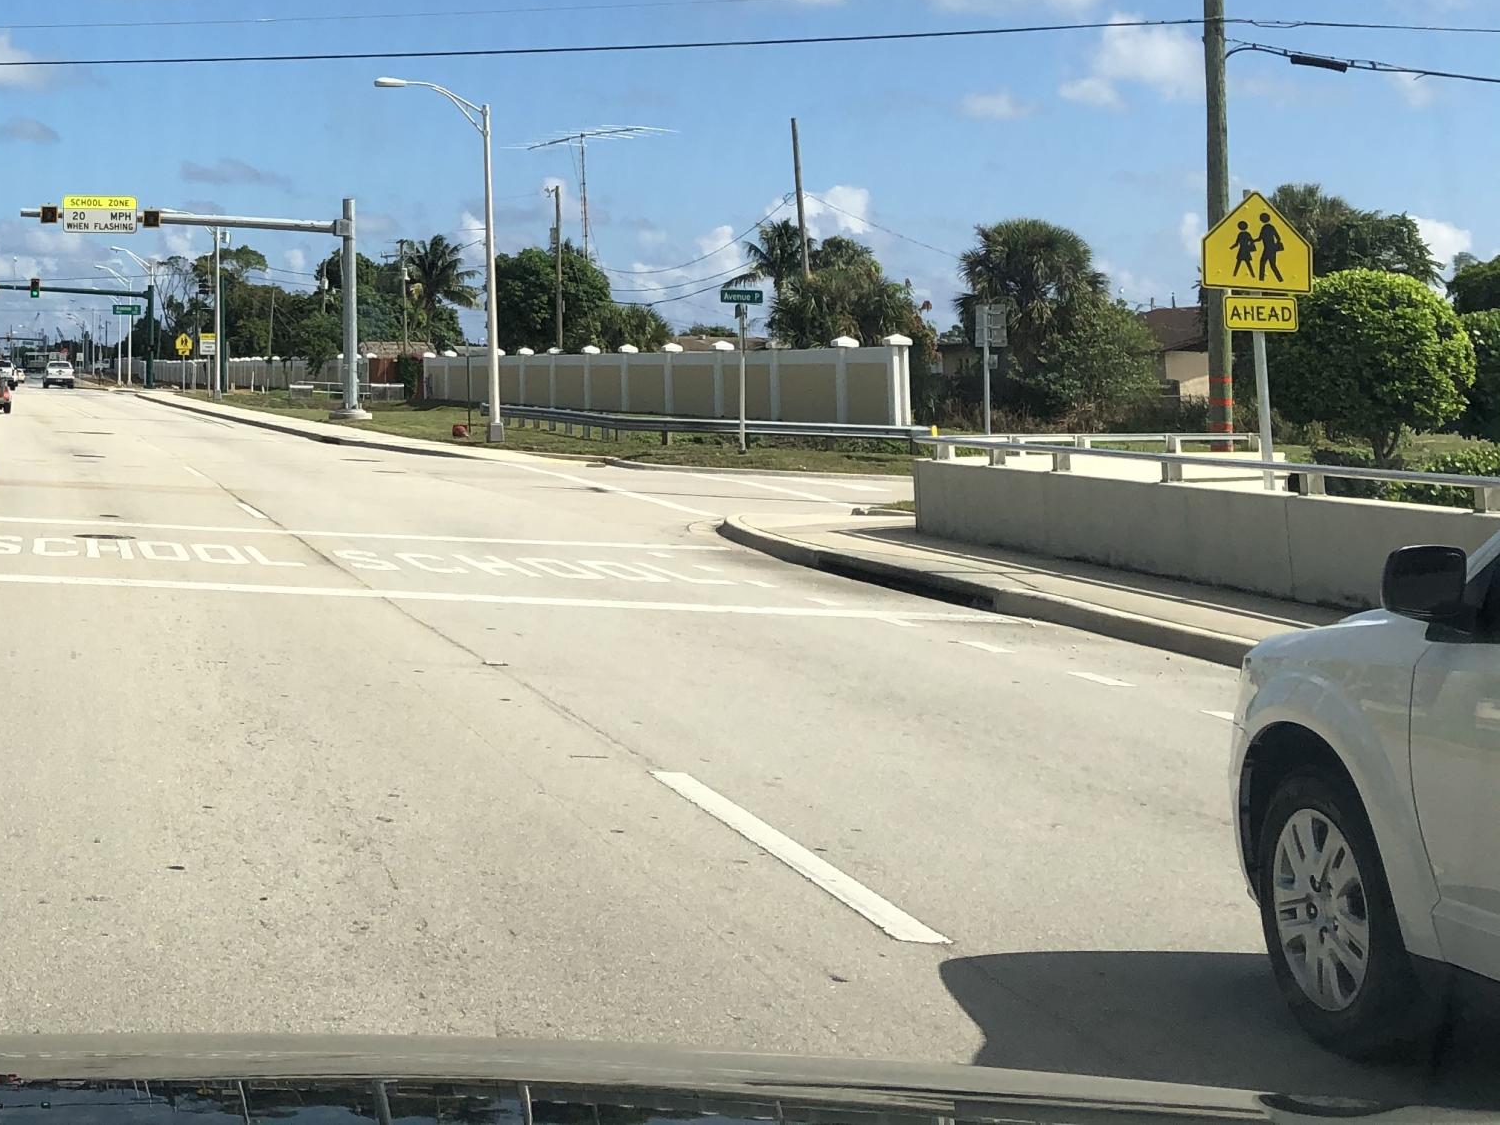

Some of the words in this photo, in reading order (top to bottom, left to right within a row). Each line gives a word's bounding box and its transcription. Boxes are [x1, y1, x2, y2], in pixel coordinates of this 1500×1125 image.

[70, 198, 103, 207] SCHOOL
[108, 199, 130, 207] ZONE
[72, 211, 86, 221] 20
[110, 212, 132, 221] MPH
[66, 222, 89, 230] WHEN
[94, 222, 134, 231] FLASHING
[723, 292, 751, 301] Avenue
[1229, 305, 1292, 322] AHEAD
[332, 549, 739, 585] SCHOOL
